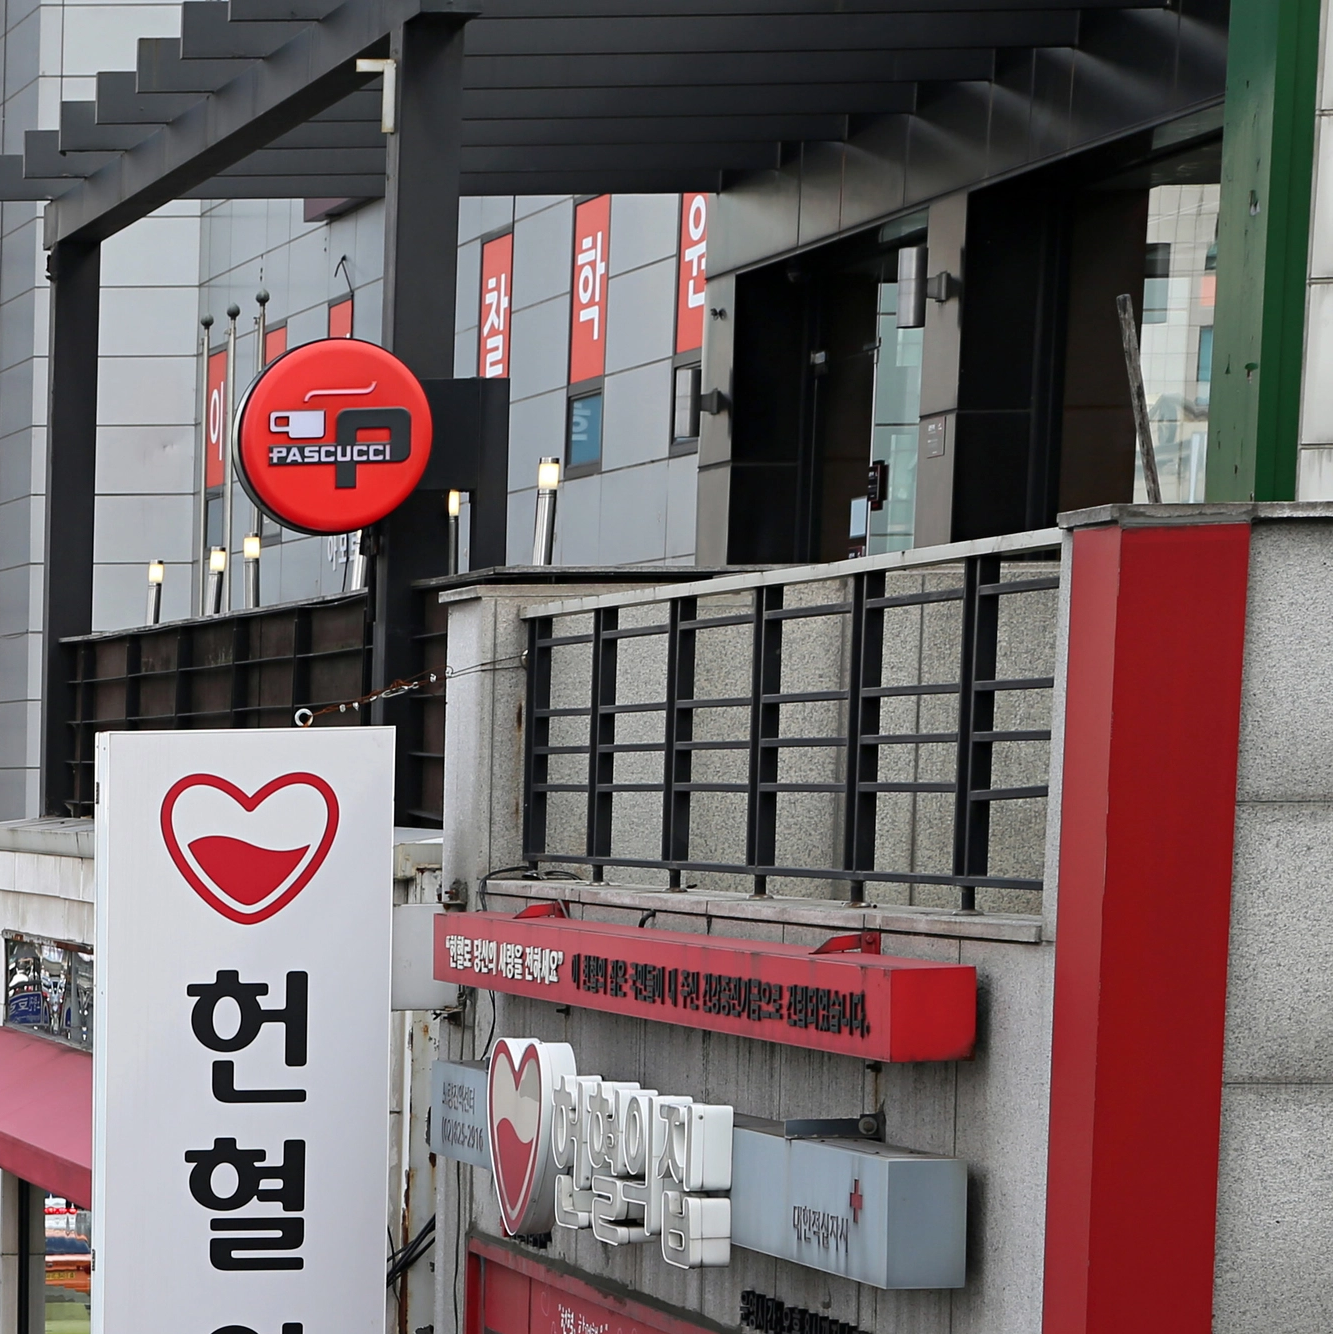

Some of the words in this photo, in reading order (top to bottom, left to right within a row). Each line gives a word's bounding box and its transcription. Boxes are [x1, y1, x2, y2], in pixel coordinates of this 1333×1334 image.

[268, 444, 391, 464] PASCUCCI
[473, 938, 497, 975] 당신의
[498, 942, 523, 981] 사랑을
[793, 1204, 850, 1254] 대한적십자사
